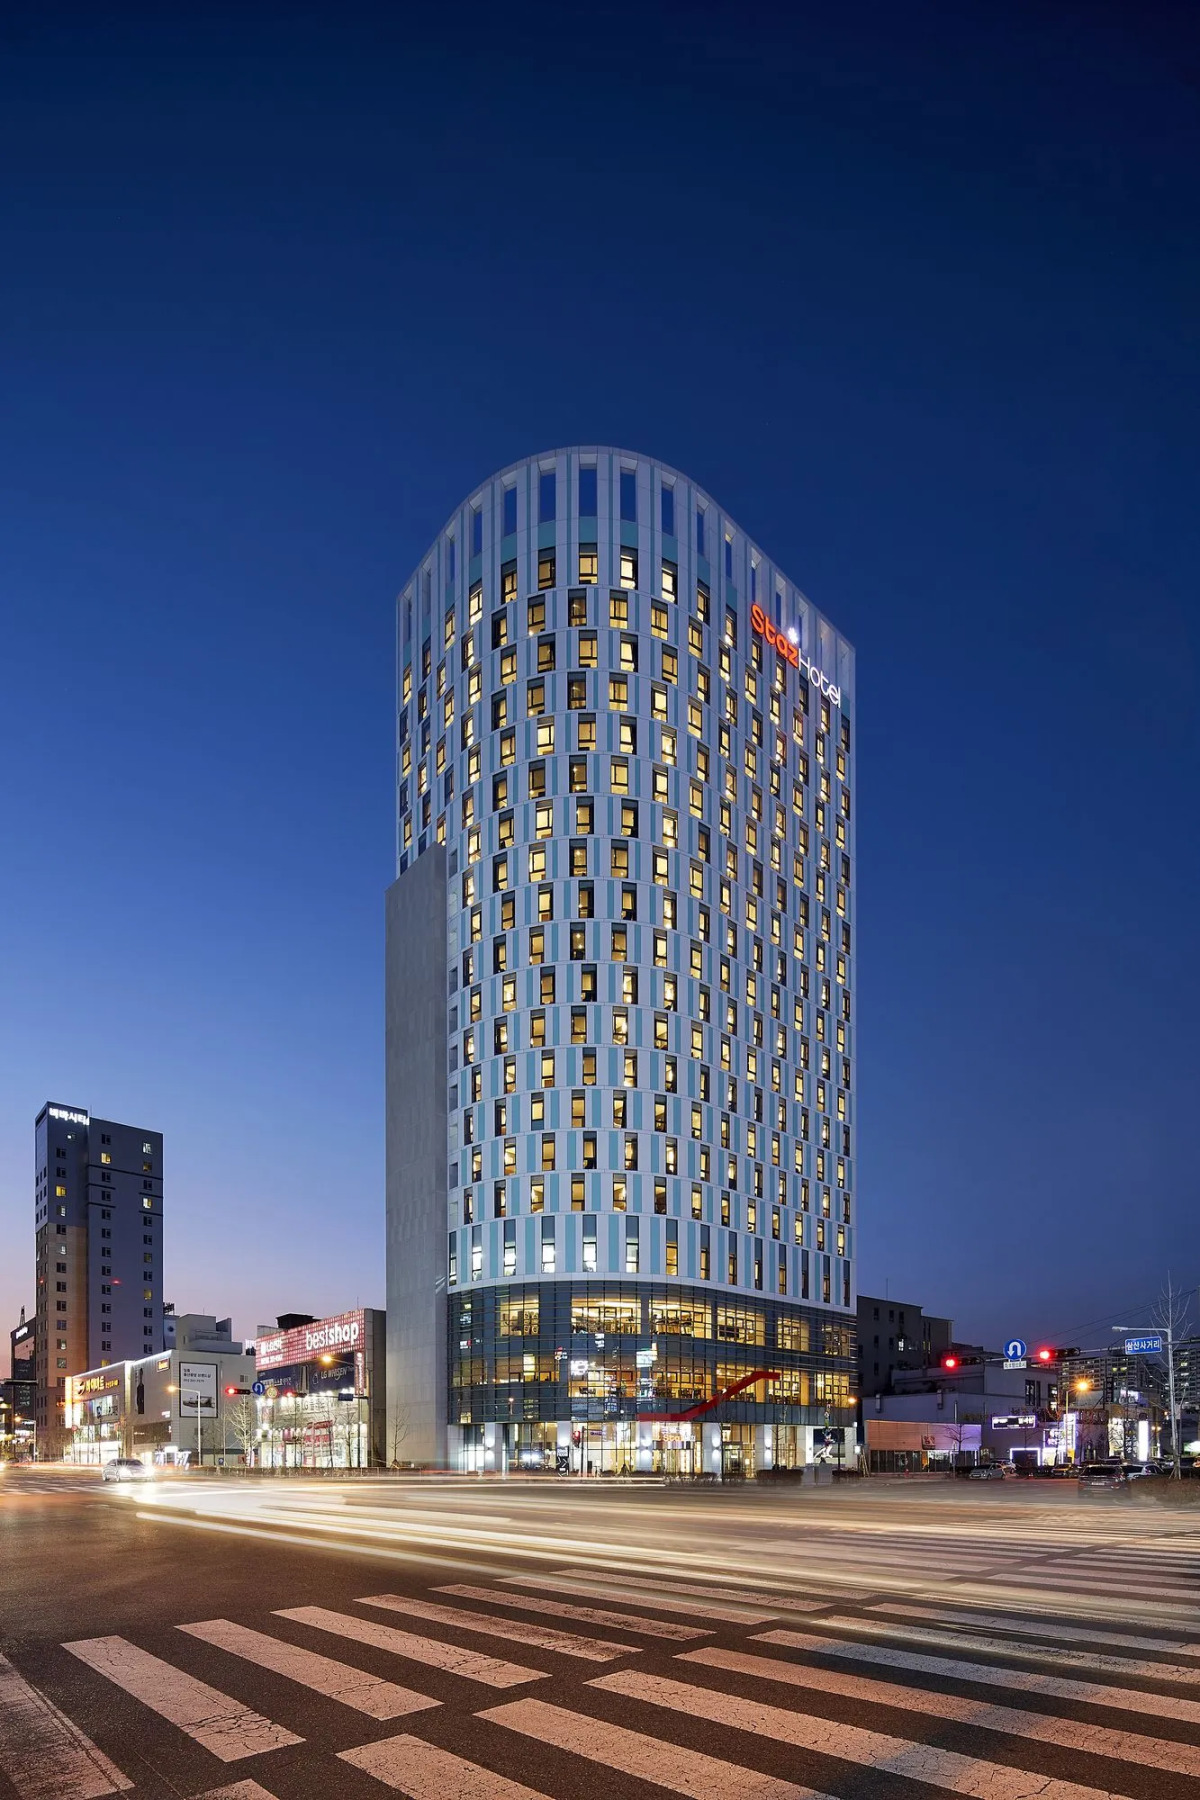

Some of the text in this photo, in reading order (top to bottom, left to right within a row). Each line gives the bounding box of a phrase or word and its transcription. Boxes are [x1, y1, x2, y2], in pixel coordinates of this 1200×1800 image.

[751, 603, 841, 708] Staz Hotel
[305, 1321, 359, 1351] bestshop
[1126, 1339, 1160, 1351] 삼산사거리
